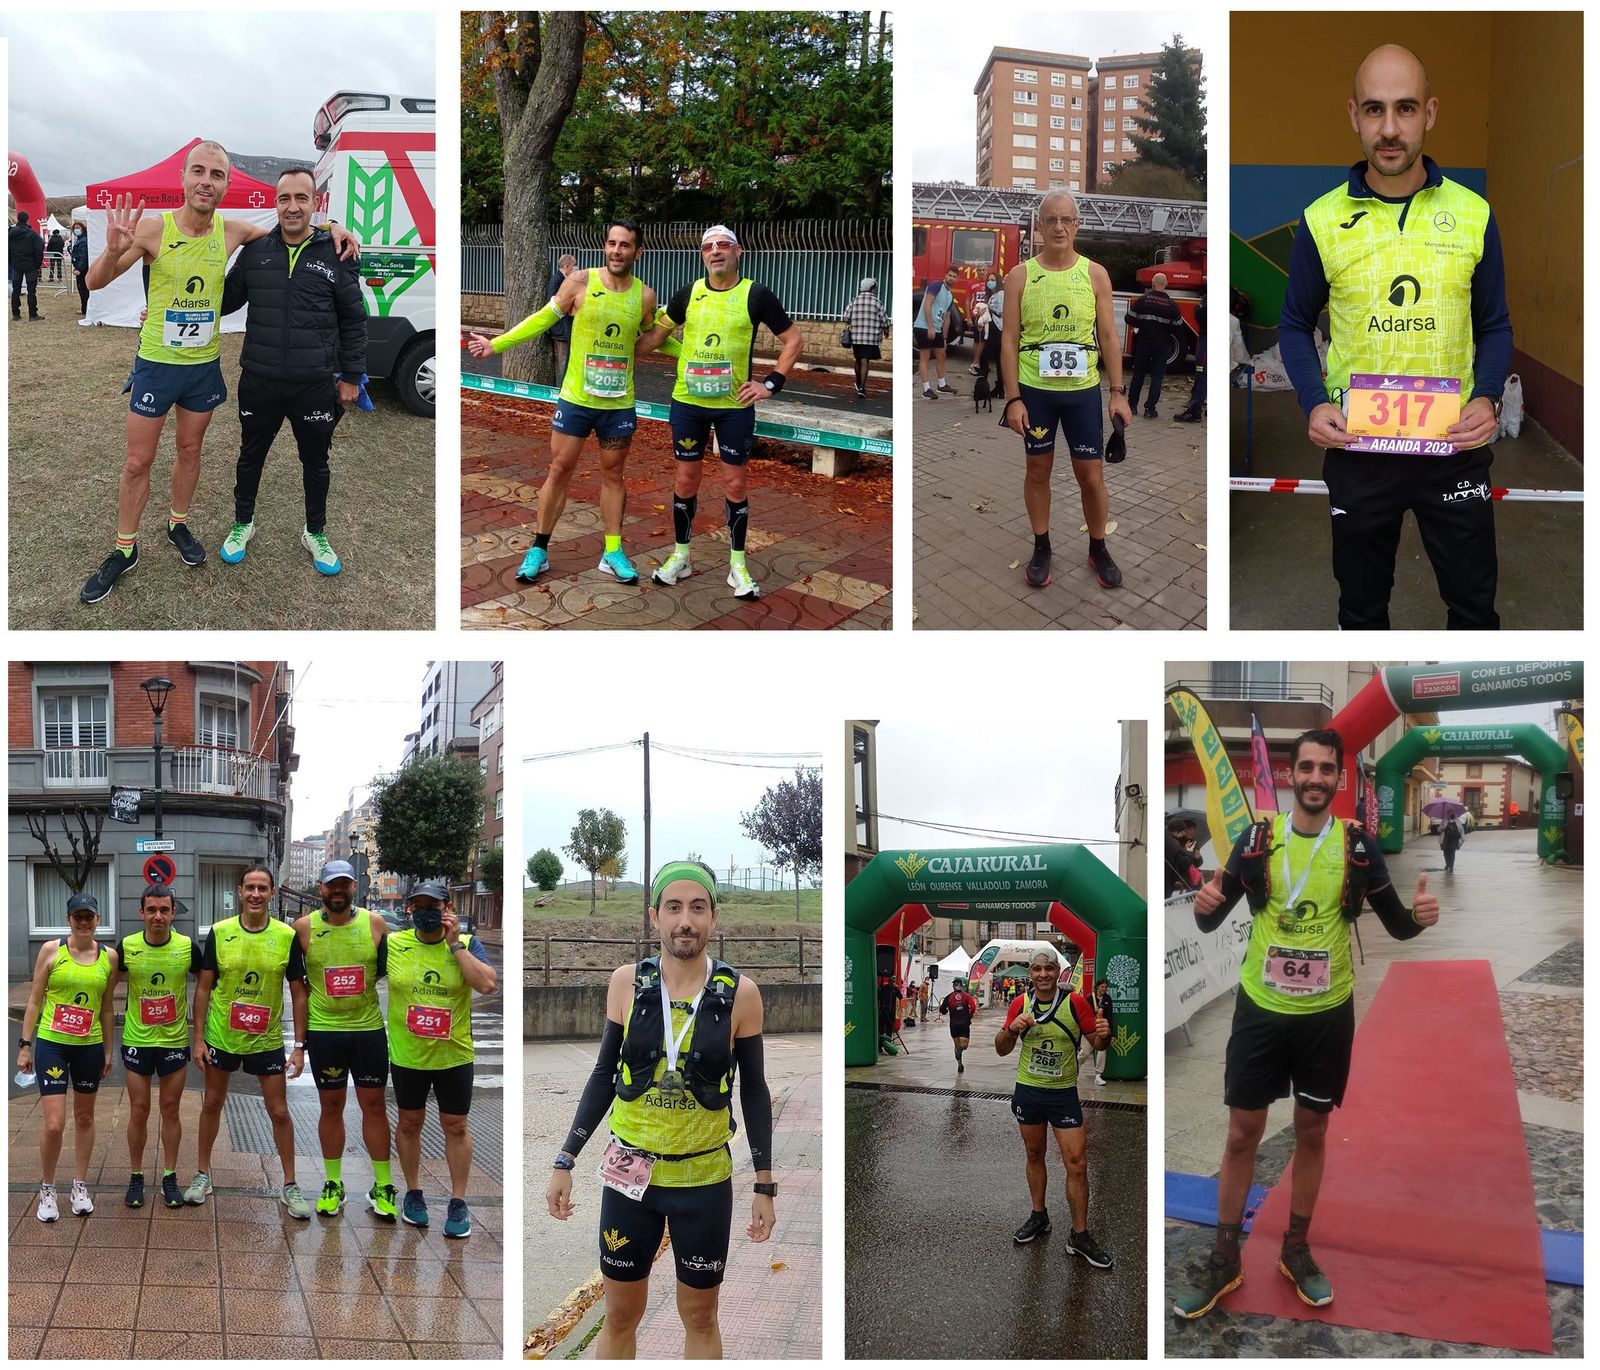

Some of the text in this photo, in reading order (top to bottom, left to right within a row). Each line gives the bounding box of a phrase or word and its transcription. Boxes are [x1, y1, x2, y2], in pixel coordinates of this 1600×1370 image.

[161, 193, 179, 204] Roja
[369, 261, 382, 269] Caja
[172, 298, 210, 308] Adarsa
[1043, 324, 1076, 333] Adarsa
[1367, 314, 1437, 333] Adarsa
[177, 323, 200, 337] 72
[593, 340, 624, 351] Adarsa
[693, 350, 725, 361] Adarsa
[1049, 350, 1078, 370] 85
[595, 375, 625, 386] 2053
[695, 382, 730, 393] 1615
[134, 401, 157, 413] Adarsa
[1368, 392, 1436, 428] 317
[1370, 438, 1453, 454] ARANDA 2021
[1457, 480, 1472, 489] C.D.
[1471, 661, 1572, 679] CON EL DEPORTE
[1471, 670, 1572, 694] GANAMOS TODOS
[1423, 684, 1457, 694] ZAMORA
[1442, 729, 1514, 742] CAJARURAL
[928, 854, 1048, 874] CAJARURAL
[908, 879, 1048, 891] LEÓN OURENSE VALLADOLID ZAMORA
[975, 901, 1010, 910] GANAMOS
[1011, 901, 1036, 910] TODOS
[1282, 960, 1311, 979] 64
[333, 975, 356, 986] 252
[142, 988, 170, 997] Adarsa
[233, 986, 263, 996] Adarsa
[411, 986, 448, 996] Adarsa
[148, 1005, 168, 1016] 254
[62, 1012, 84, 1025] 253
[239, 1011, 260, 1023] 249
[416, 1014, 441, 1027] 251
[1035, 1055, 1056, 1067] 268
[644, 1094, 696, 1110] Adarsa
[602, 1255, 635, 1268] AQUONA
[691, 1255, 706, 1263] C.D.
